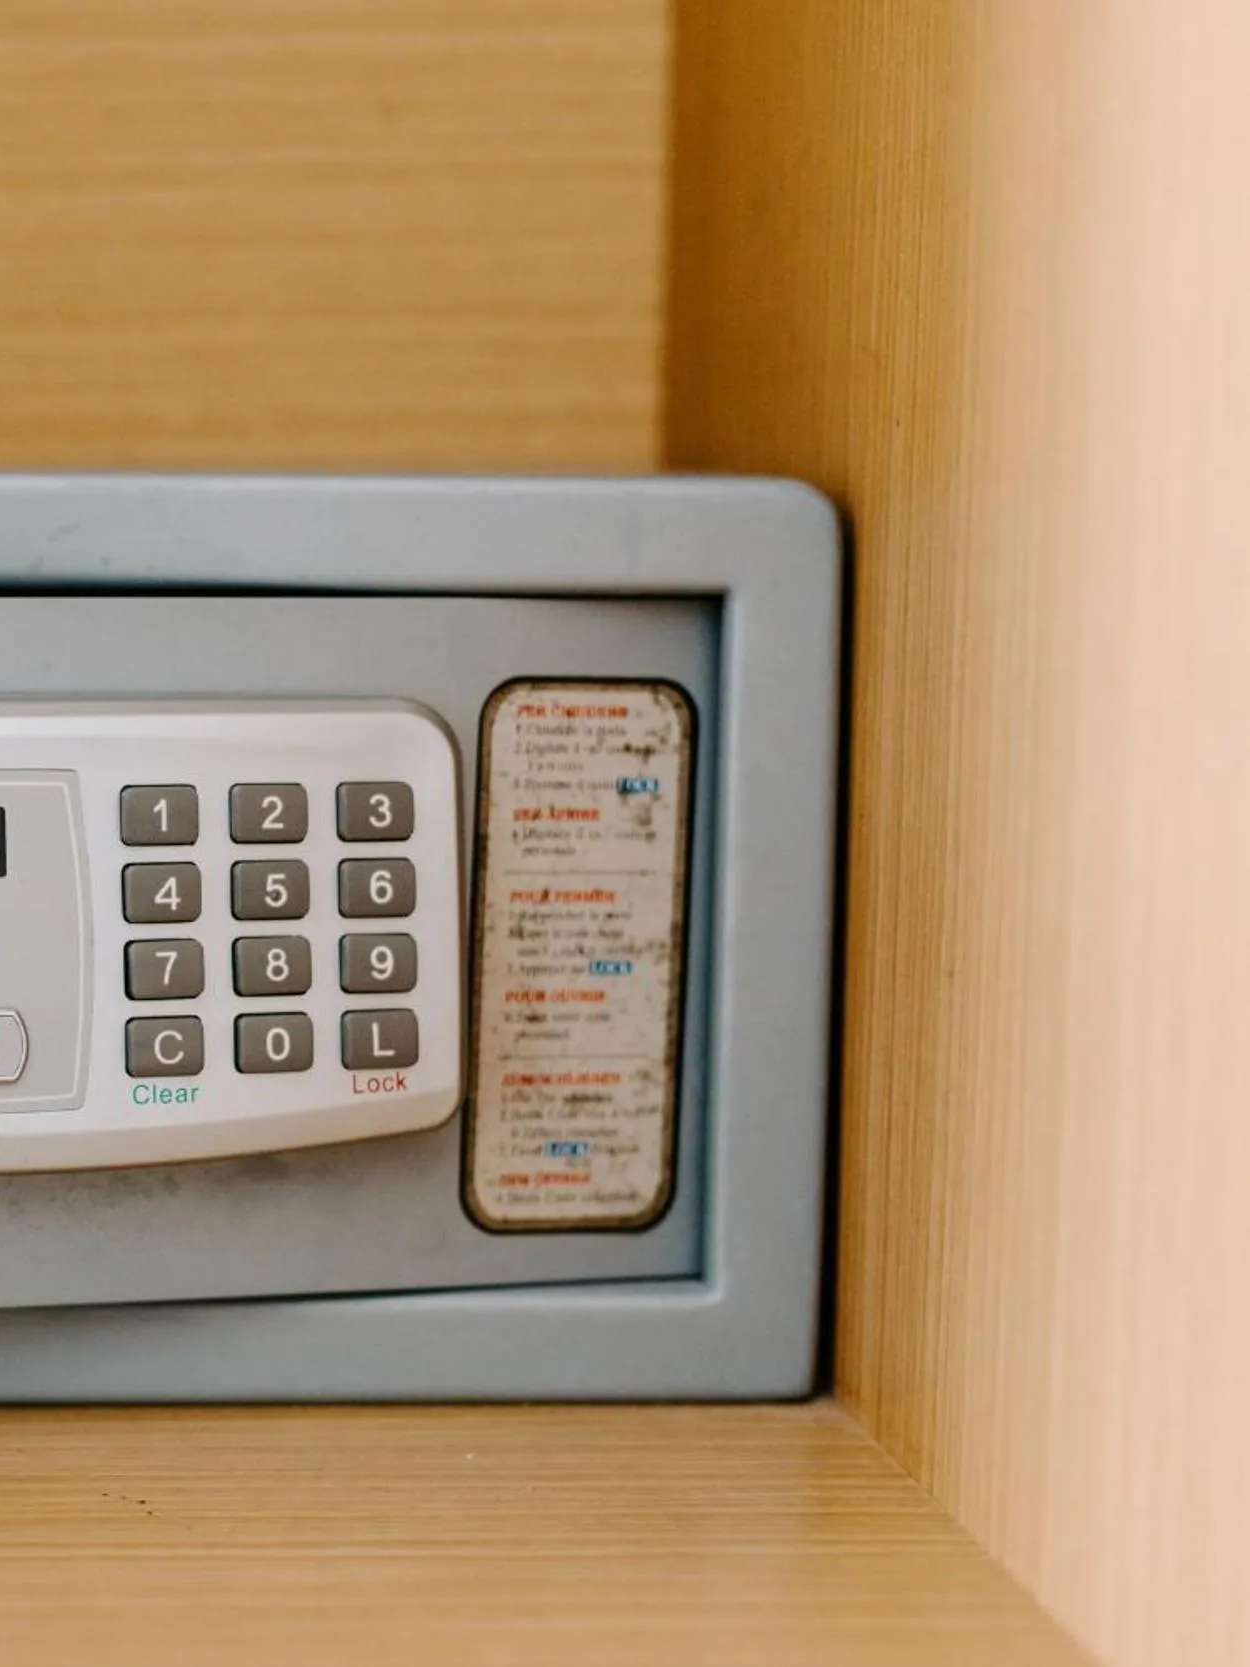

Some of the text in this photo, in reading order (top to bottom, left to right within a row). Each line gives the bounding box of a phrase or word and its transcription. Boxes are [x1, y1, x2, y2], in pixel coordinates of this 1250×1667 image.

[153, 799, 168, 832] 1
[261, 795, 285, 829] 2
[368, 793, 392, 828] 3
[154, 876, 181, 911] 4
[264, 873, 288, 907] 5
[369, 870, 393, 904] 6
[154, 951, 178, 985] 7
[265, 948, 289, 982] 8
[369, 945, 394, 980] 9
[153, 1030, 185, 1065] C
[371, 1022, 395, 1057] L
[132, 1084, 201, 1105] Clear
[351, 1073, 407, 1094] Lock
